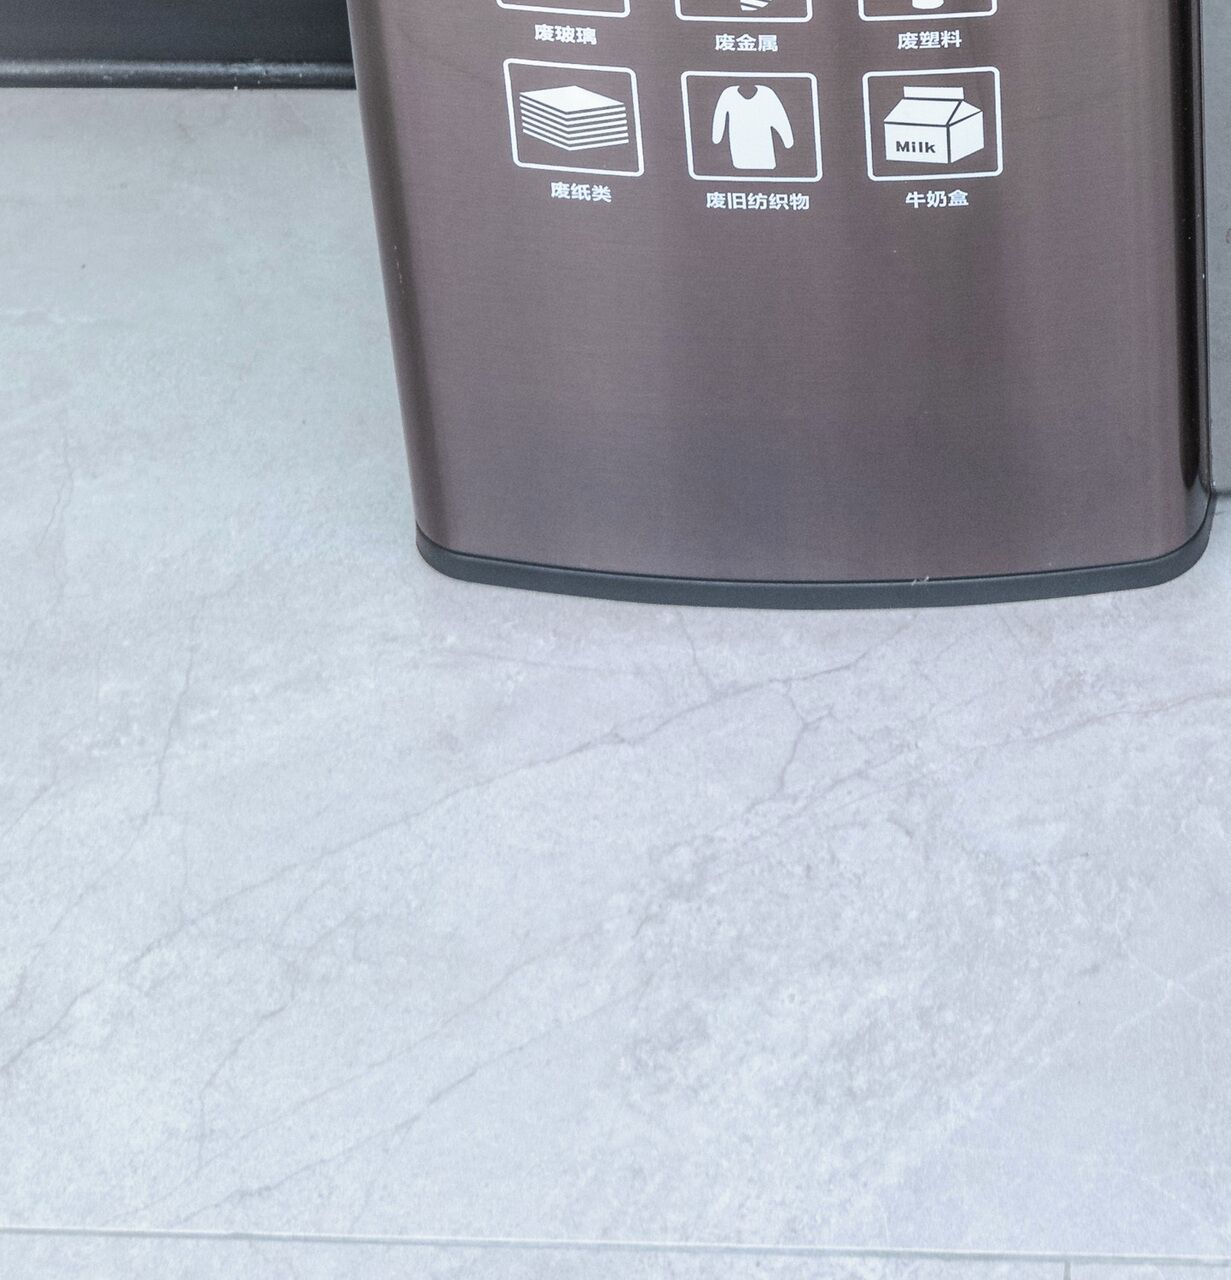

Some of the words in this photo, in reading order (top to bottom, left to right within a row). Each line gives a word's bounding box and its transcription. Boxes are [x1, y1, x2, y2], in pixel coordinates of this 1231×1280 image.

[534, 23, 598, 46] 废玻璃
[714, 33, 779, 52] 废金属
[897, 29, 963, 51] 废塑料
[895, 140, 936, 154] Milk
[550, 181, 612, 203] 废纸类
[706, 191, 810, 211] 废旧纺织物
[905, 189, 969, 209] 牛奶盒
